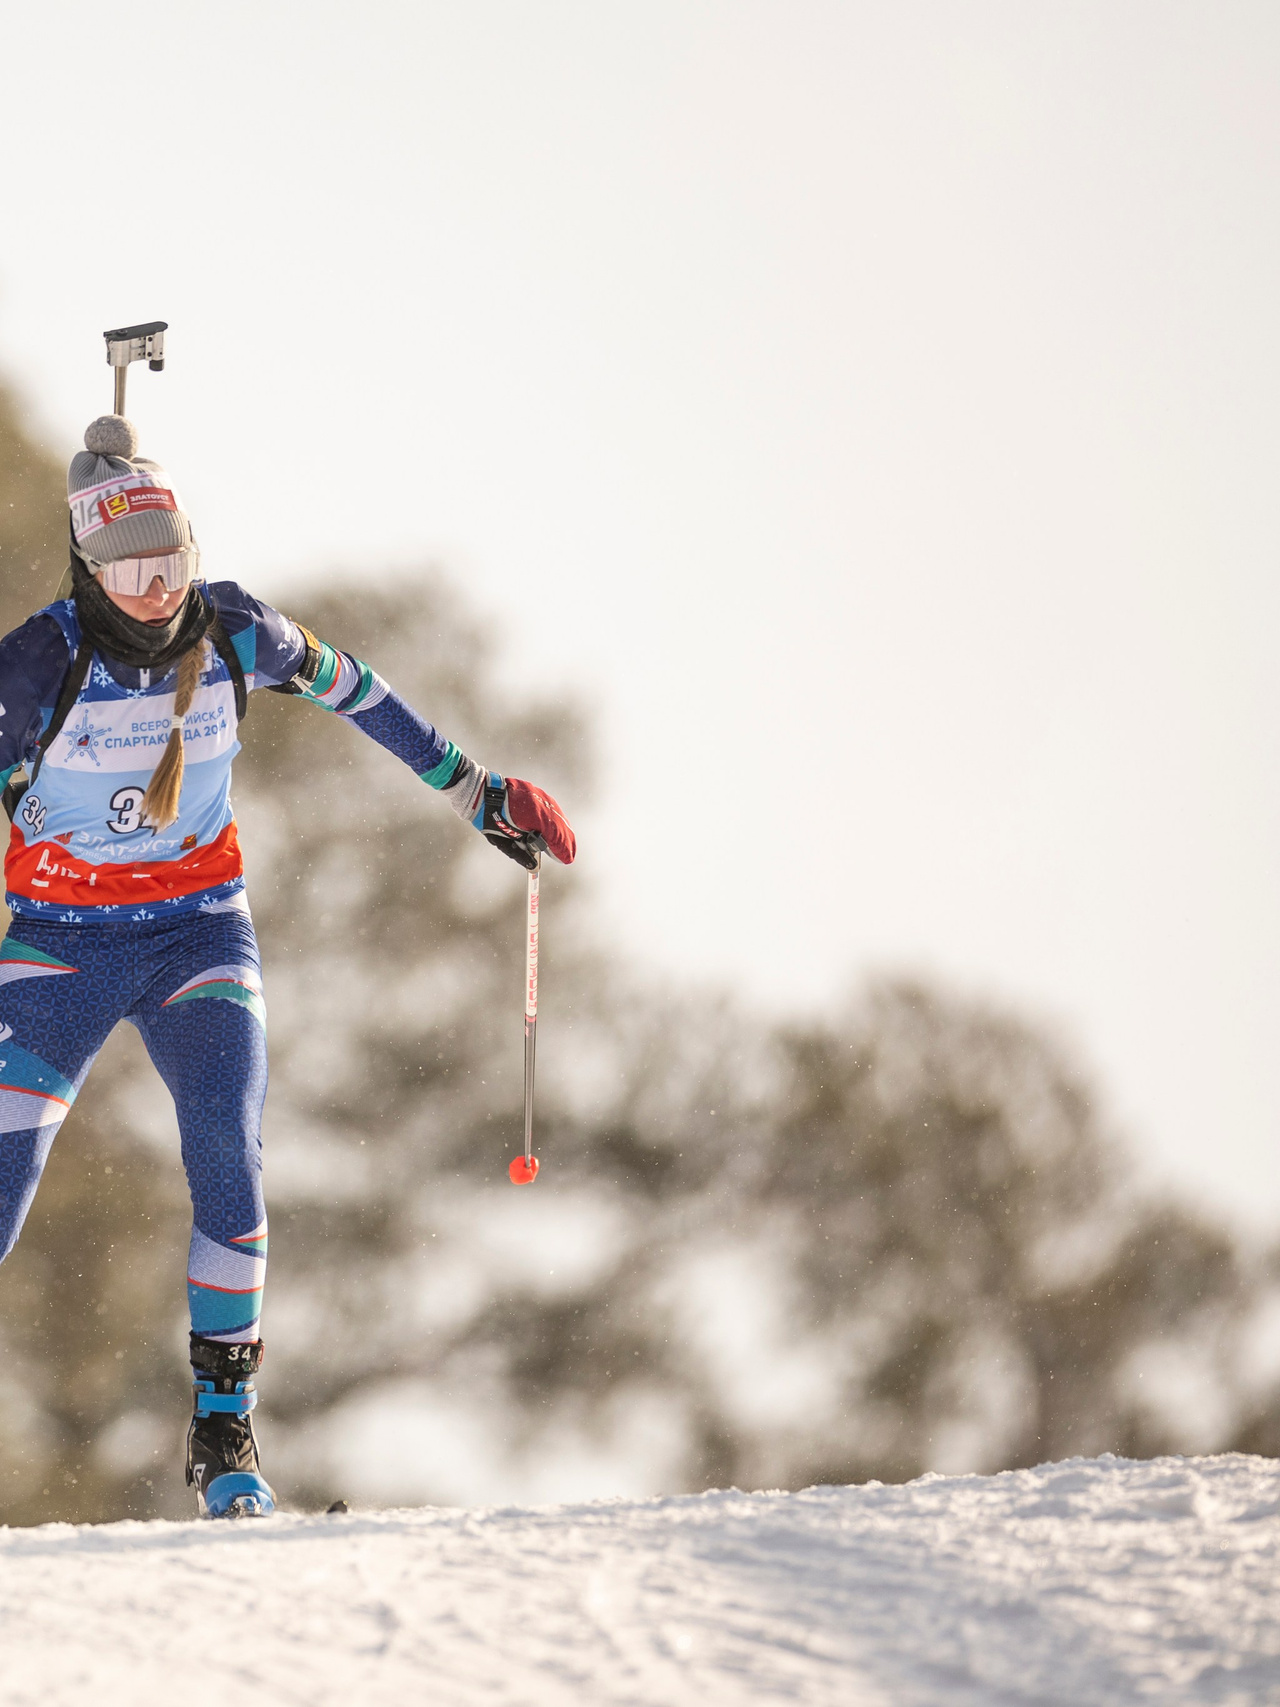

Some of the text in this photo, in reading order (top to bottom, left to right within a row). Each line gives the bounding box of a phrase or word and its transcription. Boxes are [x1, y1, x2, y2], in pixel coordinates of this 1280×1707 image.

[131, 706, 225, 732] ВСЕРОИЙСКЯ
[22, 795, 47, 836] 34
[227, 1345, 251, 1361] 34
